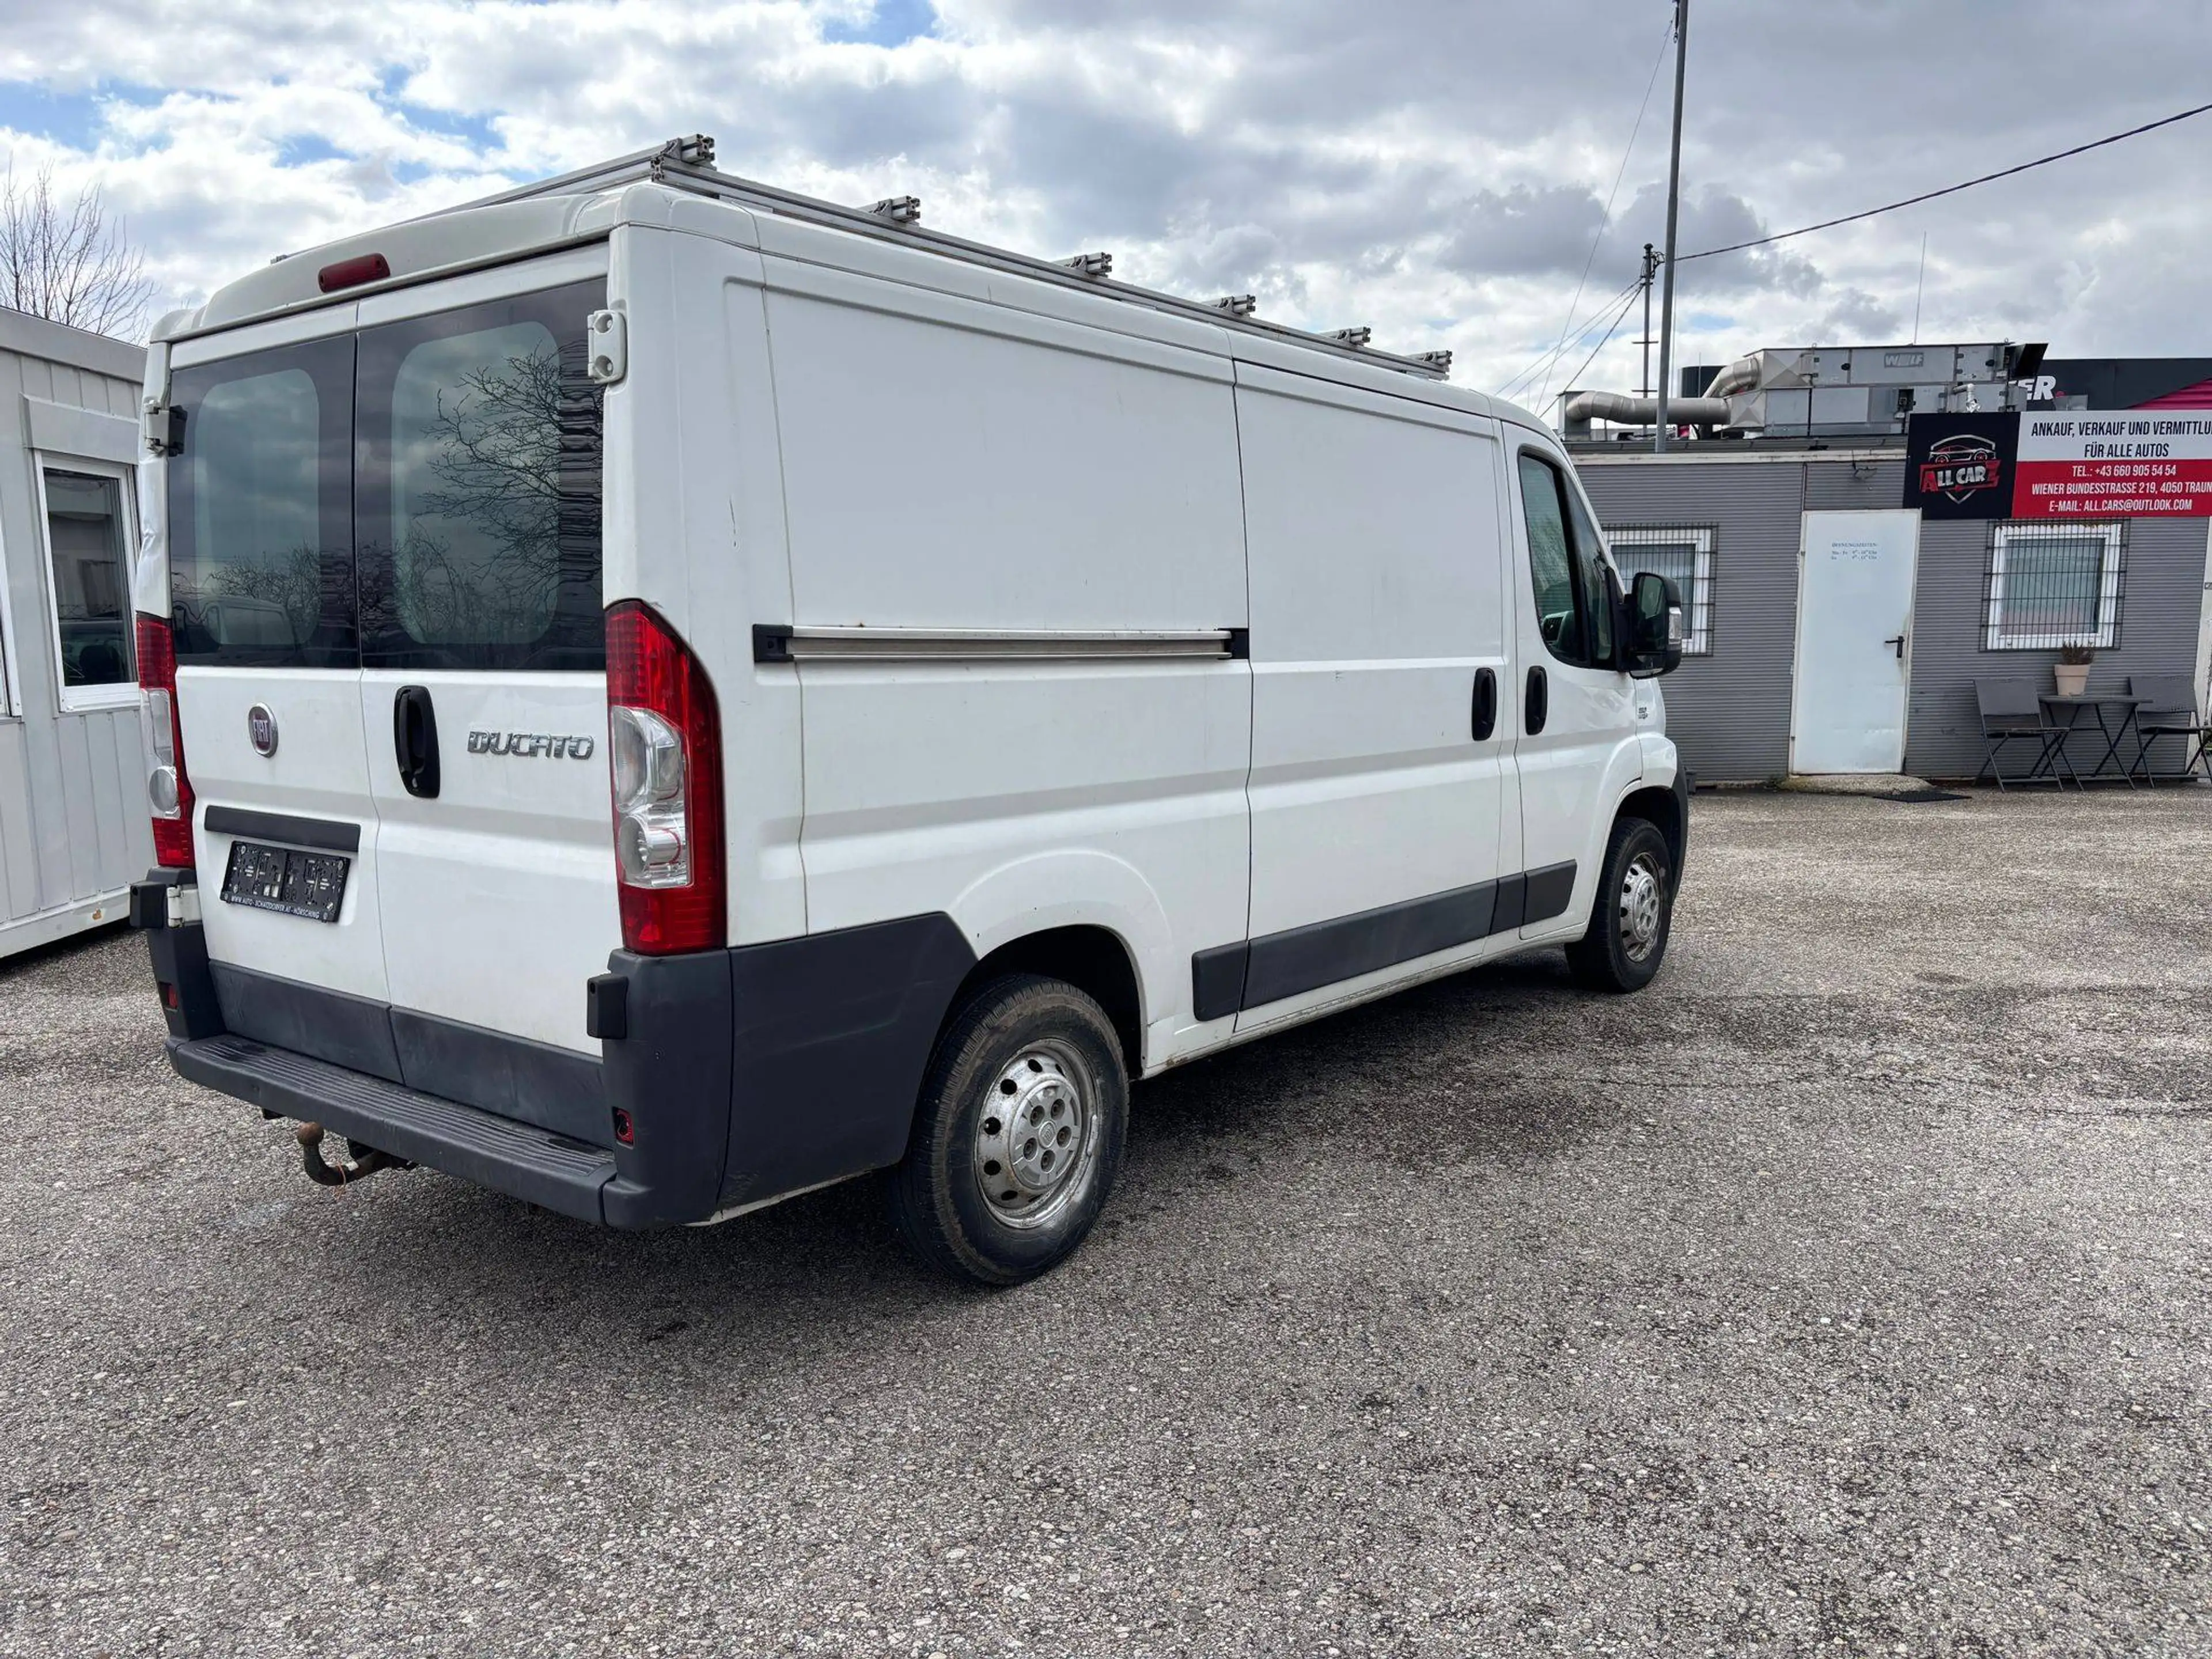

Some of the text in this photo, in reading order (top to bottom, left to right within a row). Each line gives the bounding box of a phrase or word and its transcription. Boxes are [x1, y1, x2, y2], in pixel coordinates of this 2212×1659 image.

[2031, 421, 2212, 438] ANKAUF, VERKAUF UND VERMITTLU
[2084, 441, 2169, 458] FÜR ALLE AUTOS
[2072, 464, 2176, 477] TEL.: +43 660 905 54 54
[1922, 469, 1954, 493] ALL
[2032, 483, 2065, 495] WIENER
[2066, 482, 2137, 494] BUNDESSTRASSE
[2139, 482, 2158, 494] 219,
[2160, 482, 2183, 494] 4050
[2049, 499, 2192, 512] E-MAIL: ALL.CARS@OUTLOOK.COM
[253, 719, 269, 743] FIAT
[467, 730, 594, 760] DUCATO
